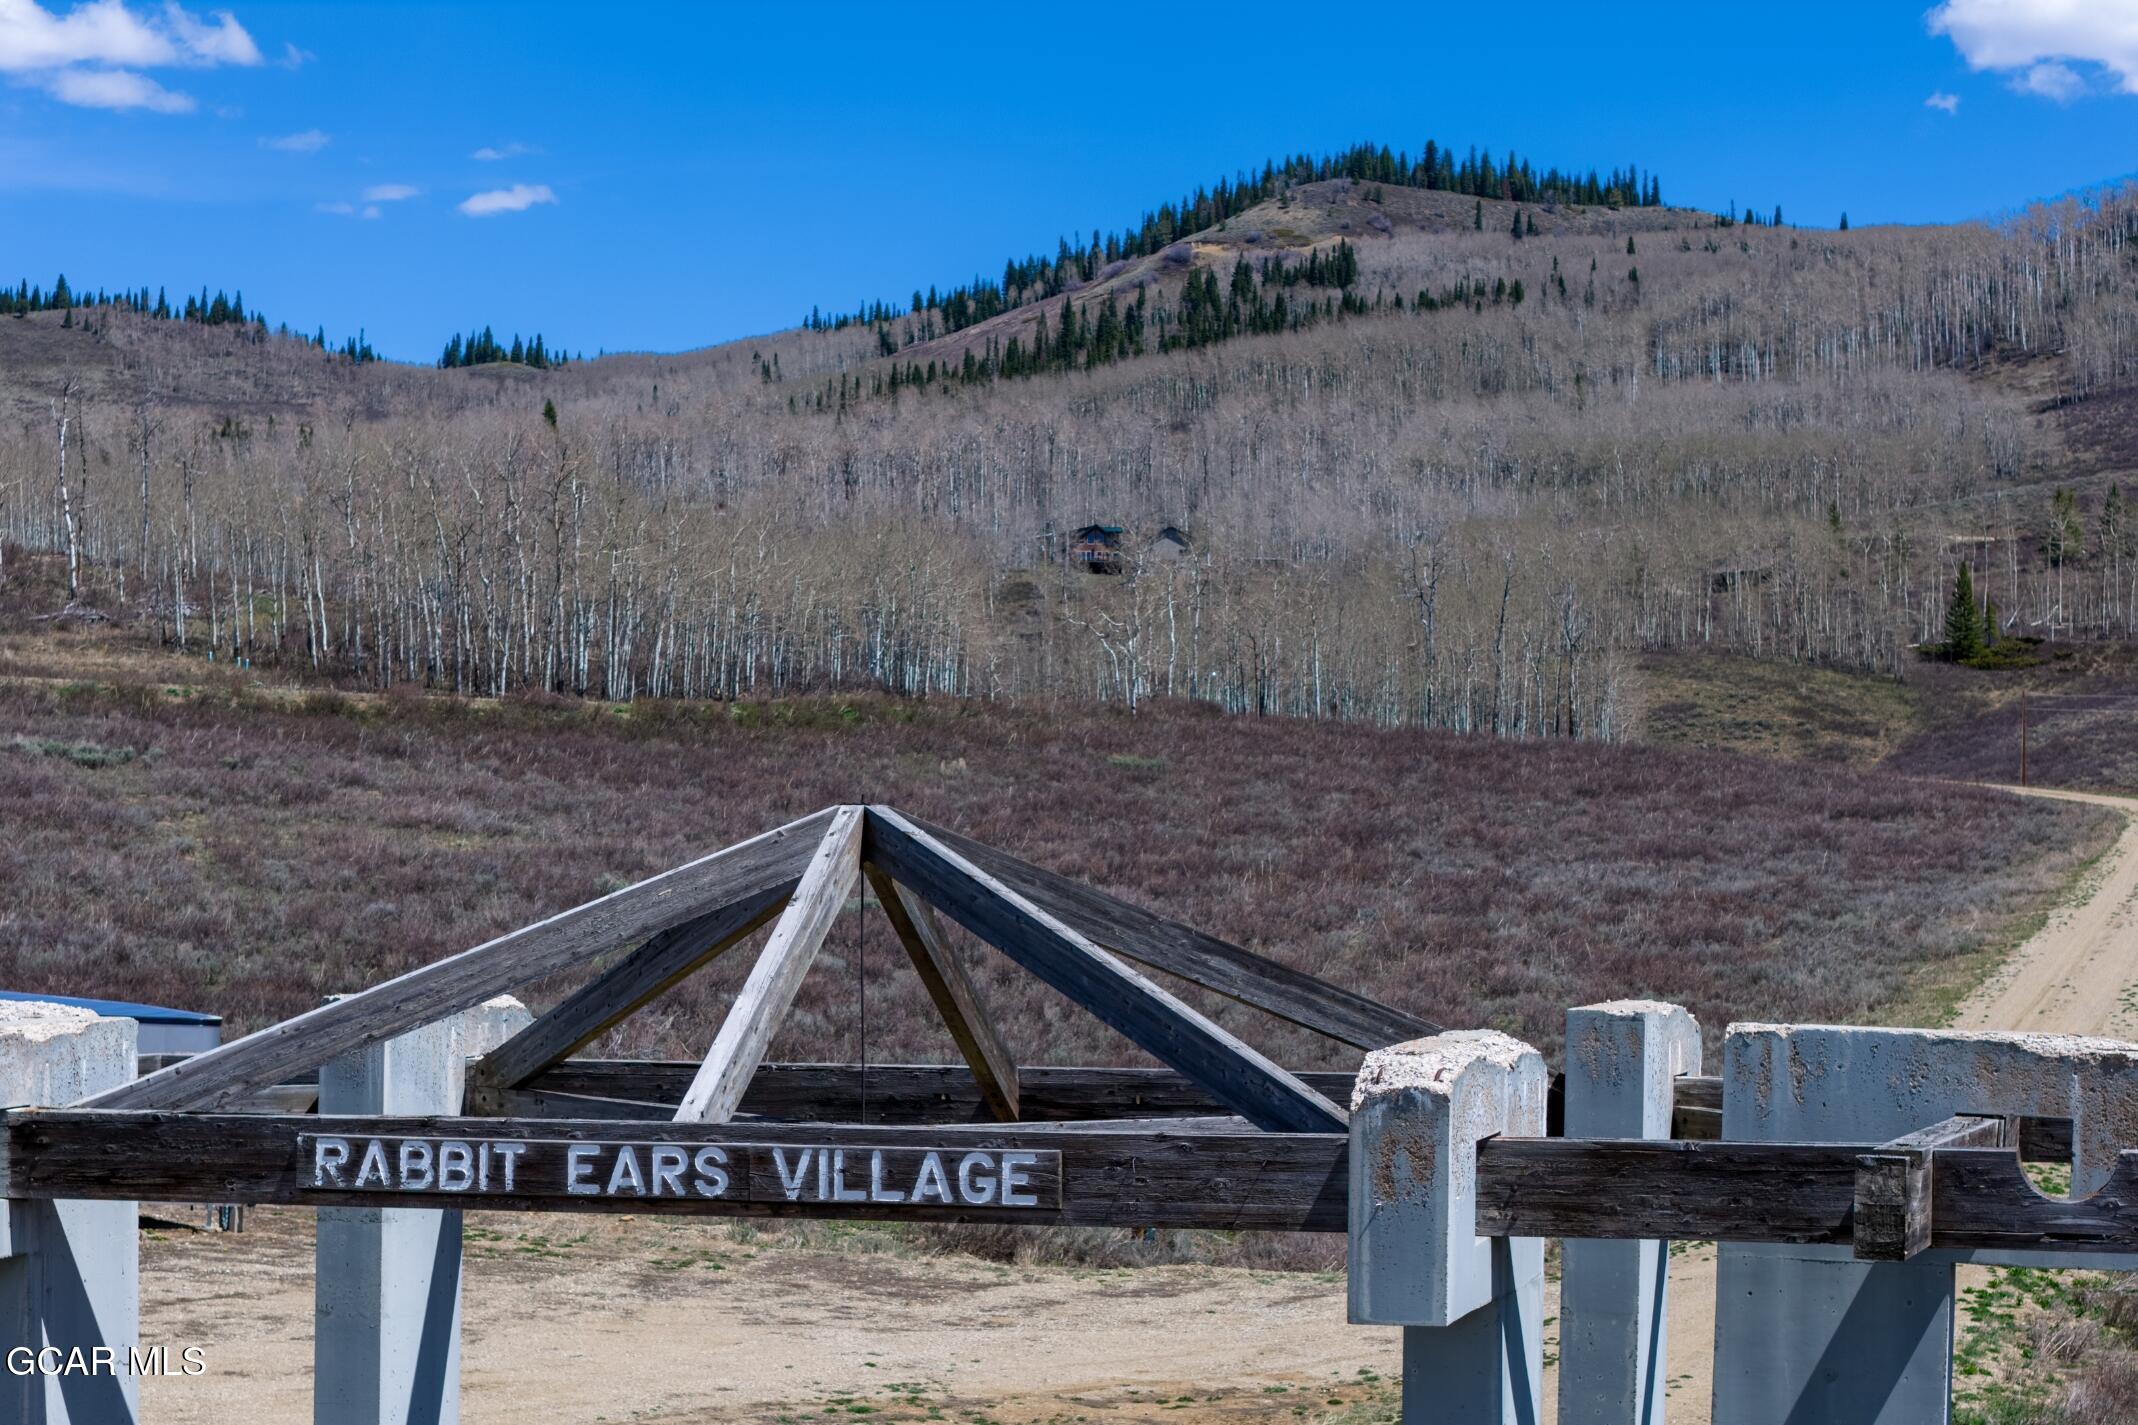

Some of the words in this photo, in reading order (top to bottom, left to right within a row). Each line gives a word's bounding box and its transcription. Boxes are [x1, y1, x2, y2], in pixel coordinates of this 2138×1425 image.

[314, 1138, 527, 1191] RABBIT
[567, 1144, 730, 1198] EARS
[772, 1147, 1038, 1205] VILLAGE
